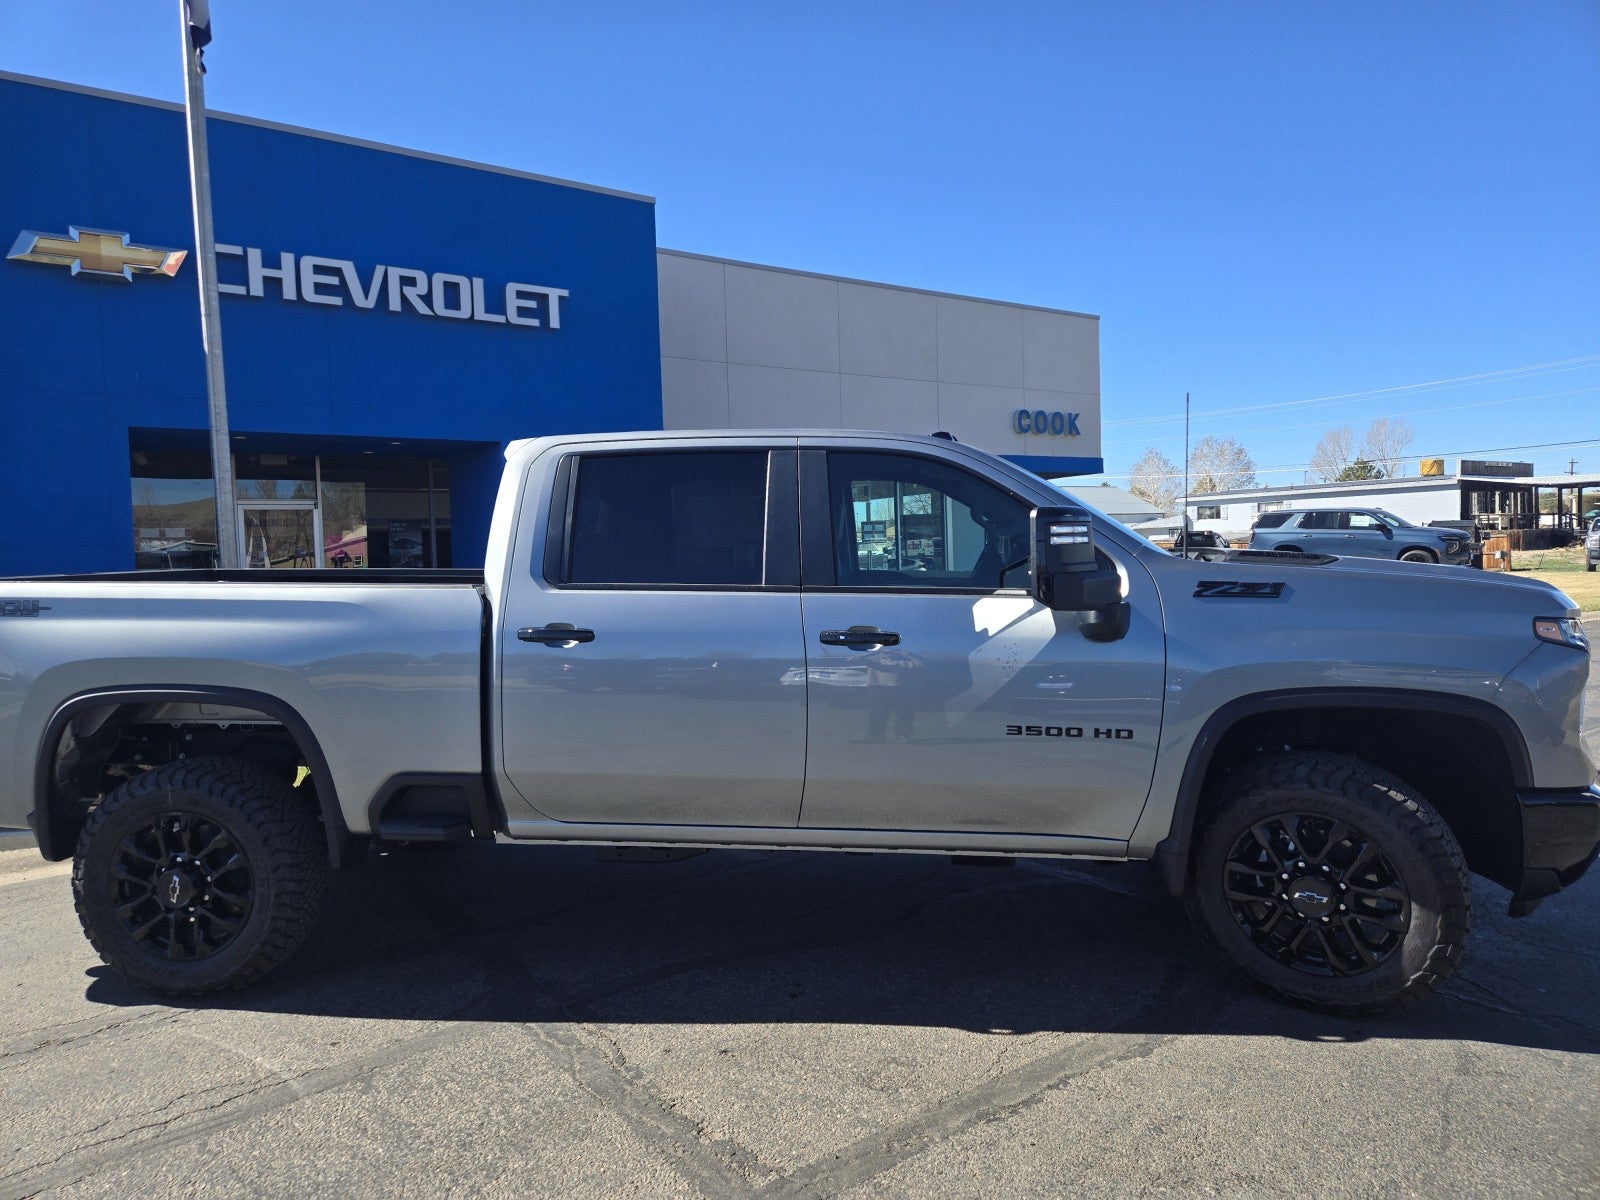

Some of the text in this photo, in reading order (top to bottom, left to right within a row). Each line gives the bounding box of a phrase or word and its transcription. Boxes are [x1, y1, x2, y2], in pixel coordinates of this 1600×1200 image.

[215, 243, 570, 329] CHEVROLET
[1014, 409, 1081, 436] COOK
[1192, 581, 1286, 598] Z71
[1006, 725, 1133, 740] 3500 HD
